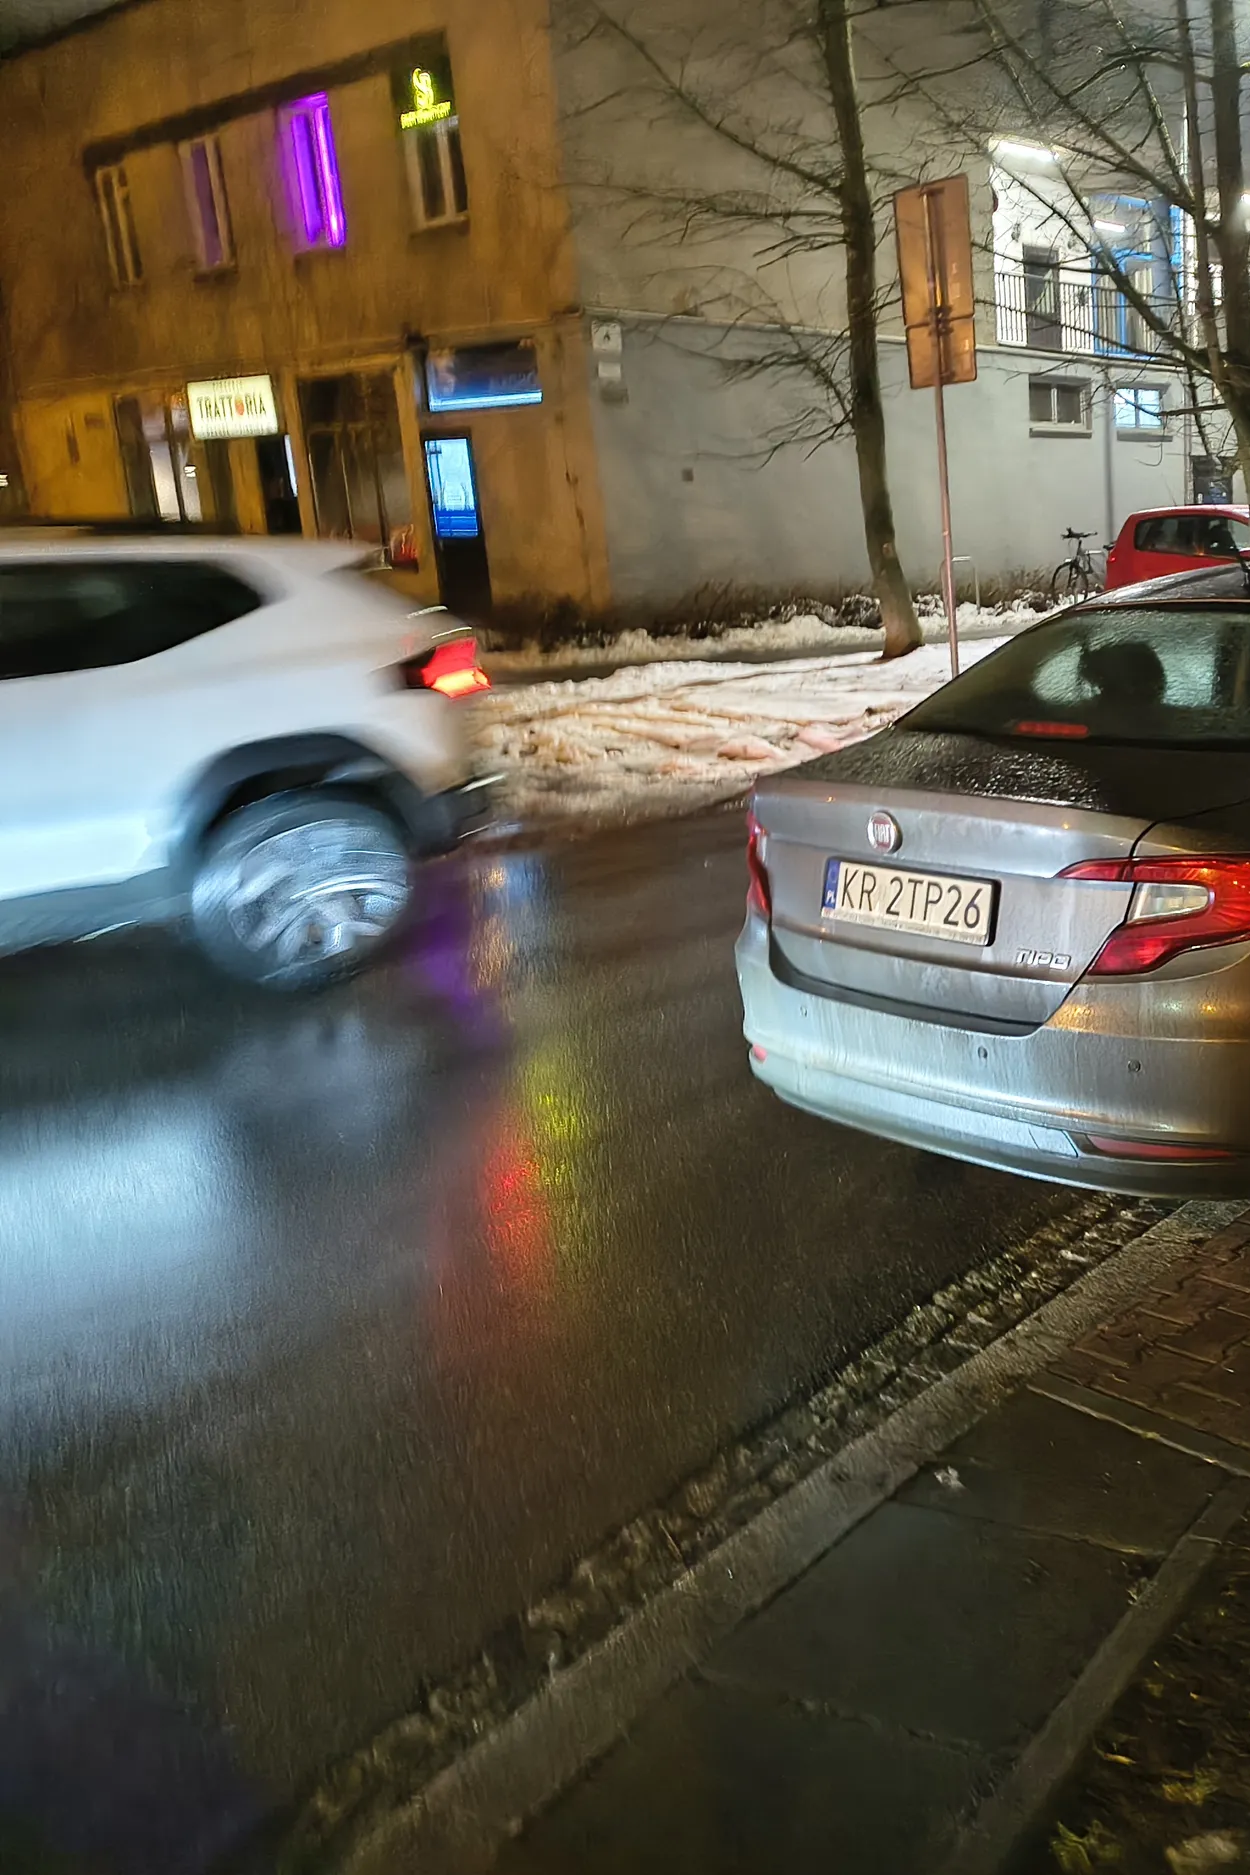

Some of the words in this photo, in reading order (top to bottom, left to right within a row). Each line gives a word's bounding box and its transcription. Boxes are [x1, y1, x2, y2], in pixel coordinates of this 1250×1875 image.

[197, 392, 267, 420] TRATTORIA
[841, 867, 877, 912] KR
[885, 875, 984, 929] 2TP26
[1016, 948, 1072, 970] TIPO
